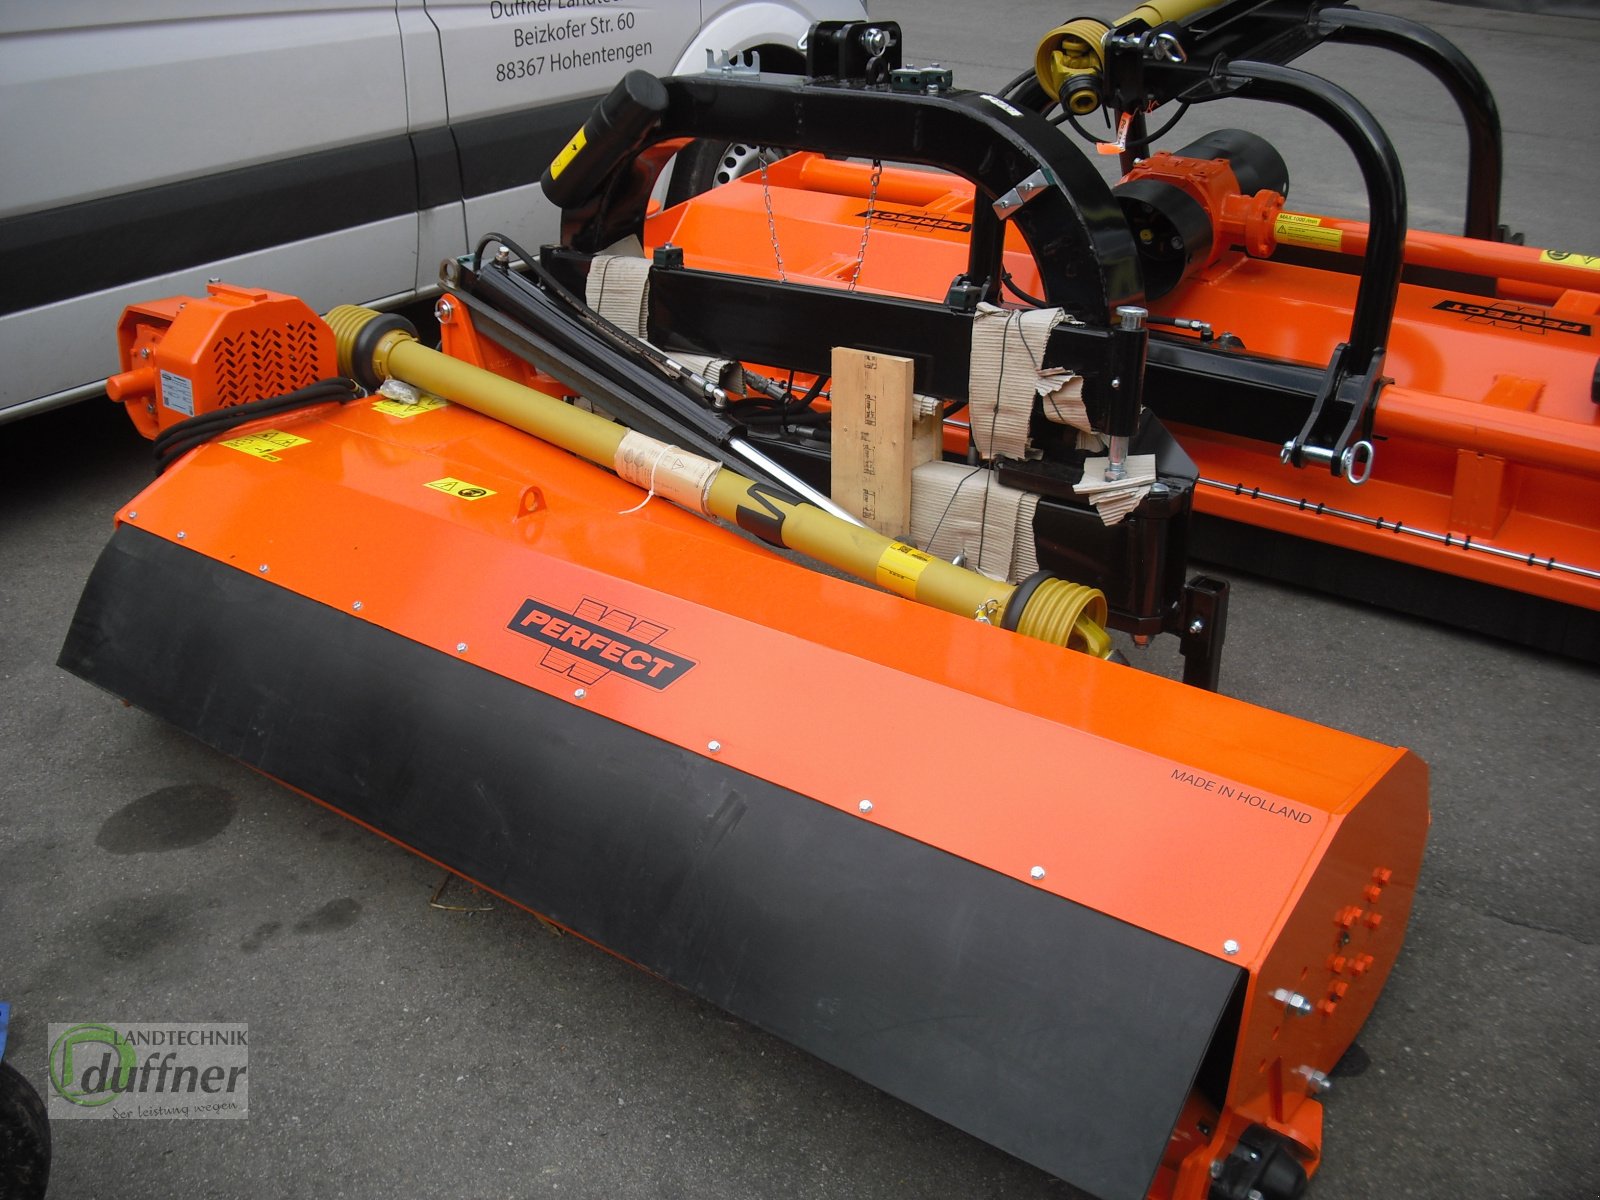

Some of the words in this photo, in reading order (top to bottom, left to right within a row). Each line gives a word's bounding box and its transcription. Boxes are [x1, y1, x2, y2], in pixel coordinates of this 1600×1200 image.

[514, 19, 587, 47] Beizkofer
[591, 16, 614, 35] Str.
[617, 12, 635, 30] 60
[496, 56, 545, 82] 88367
[550, 42, 652, 72] Hohentengen
[1446, 304, 1583, 332] PERFECT
[520, 609, 675, 678] PERFECT
[1171, 769, 1217, 791] MADE
[1217, 785, 1236, 798] IN
[1236, 791, 1312, 824] HOLLAND
